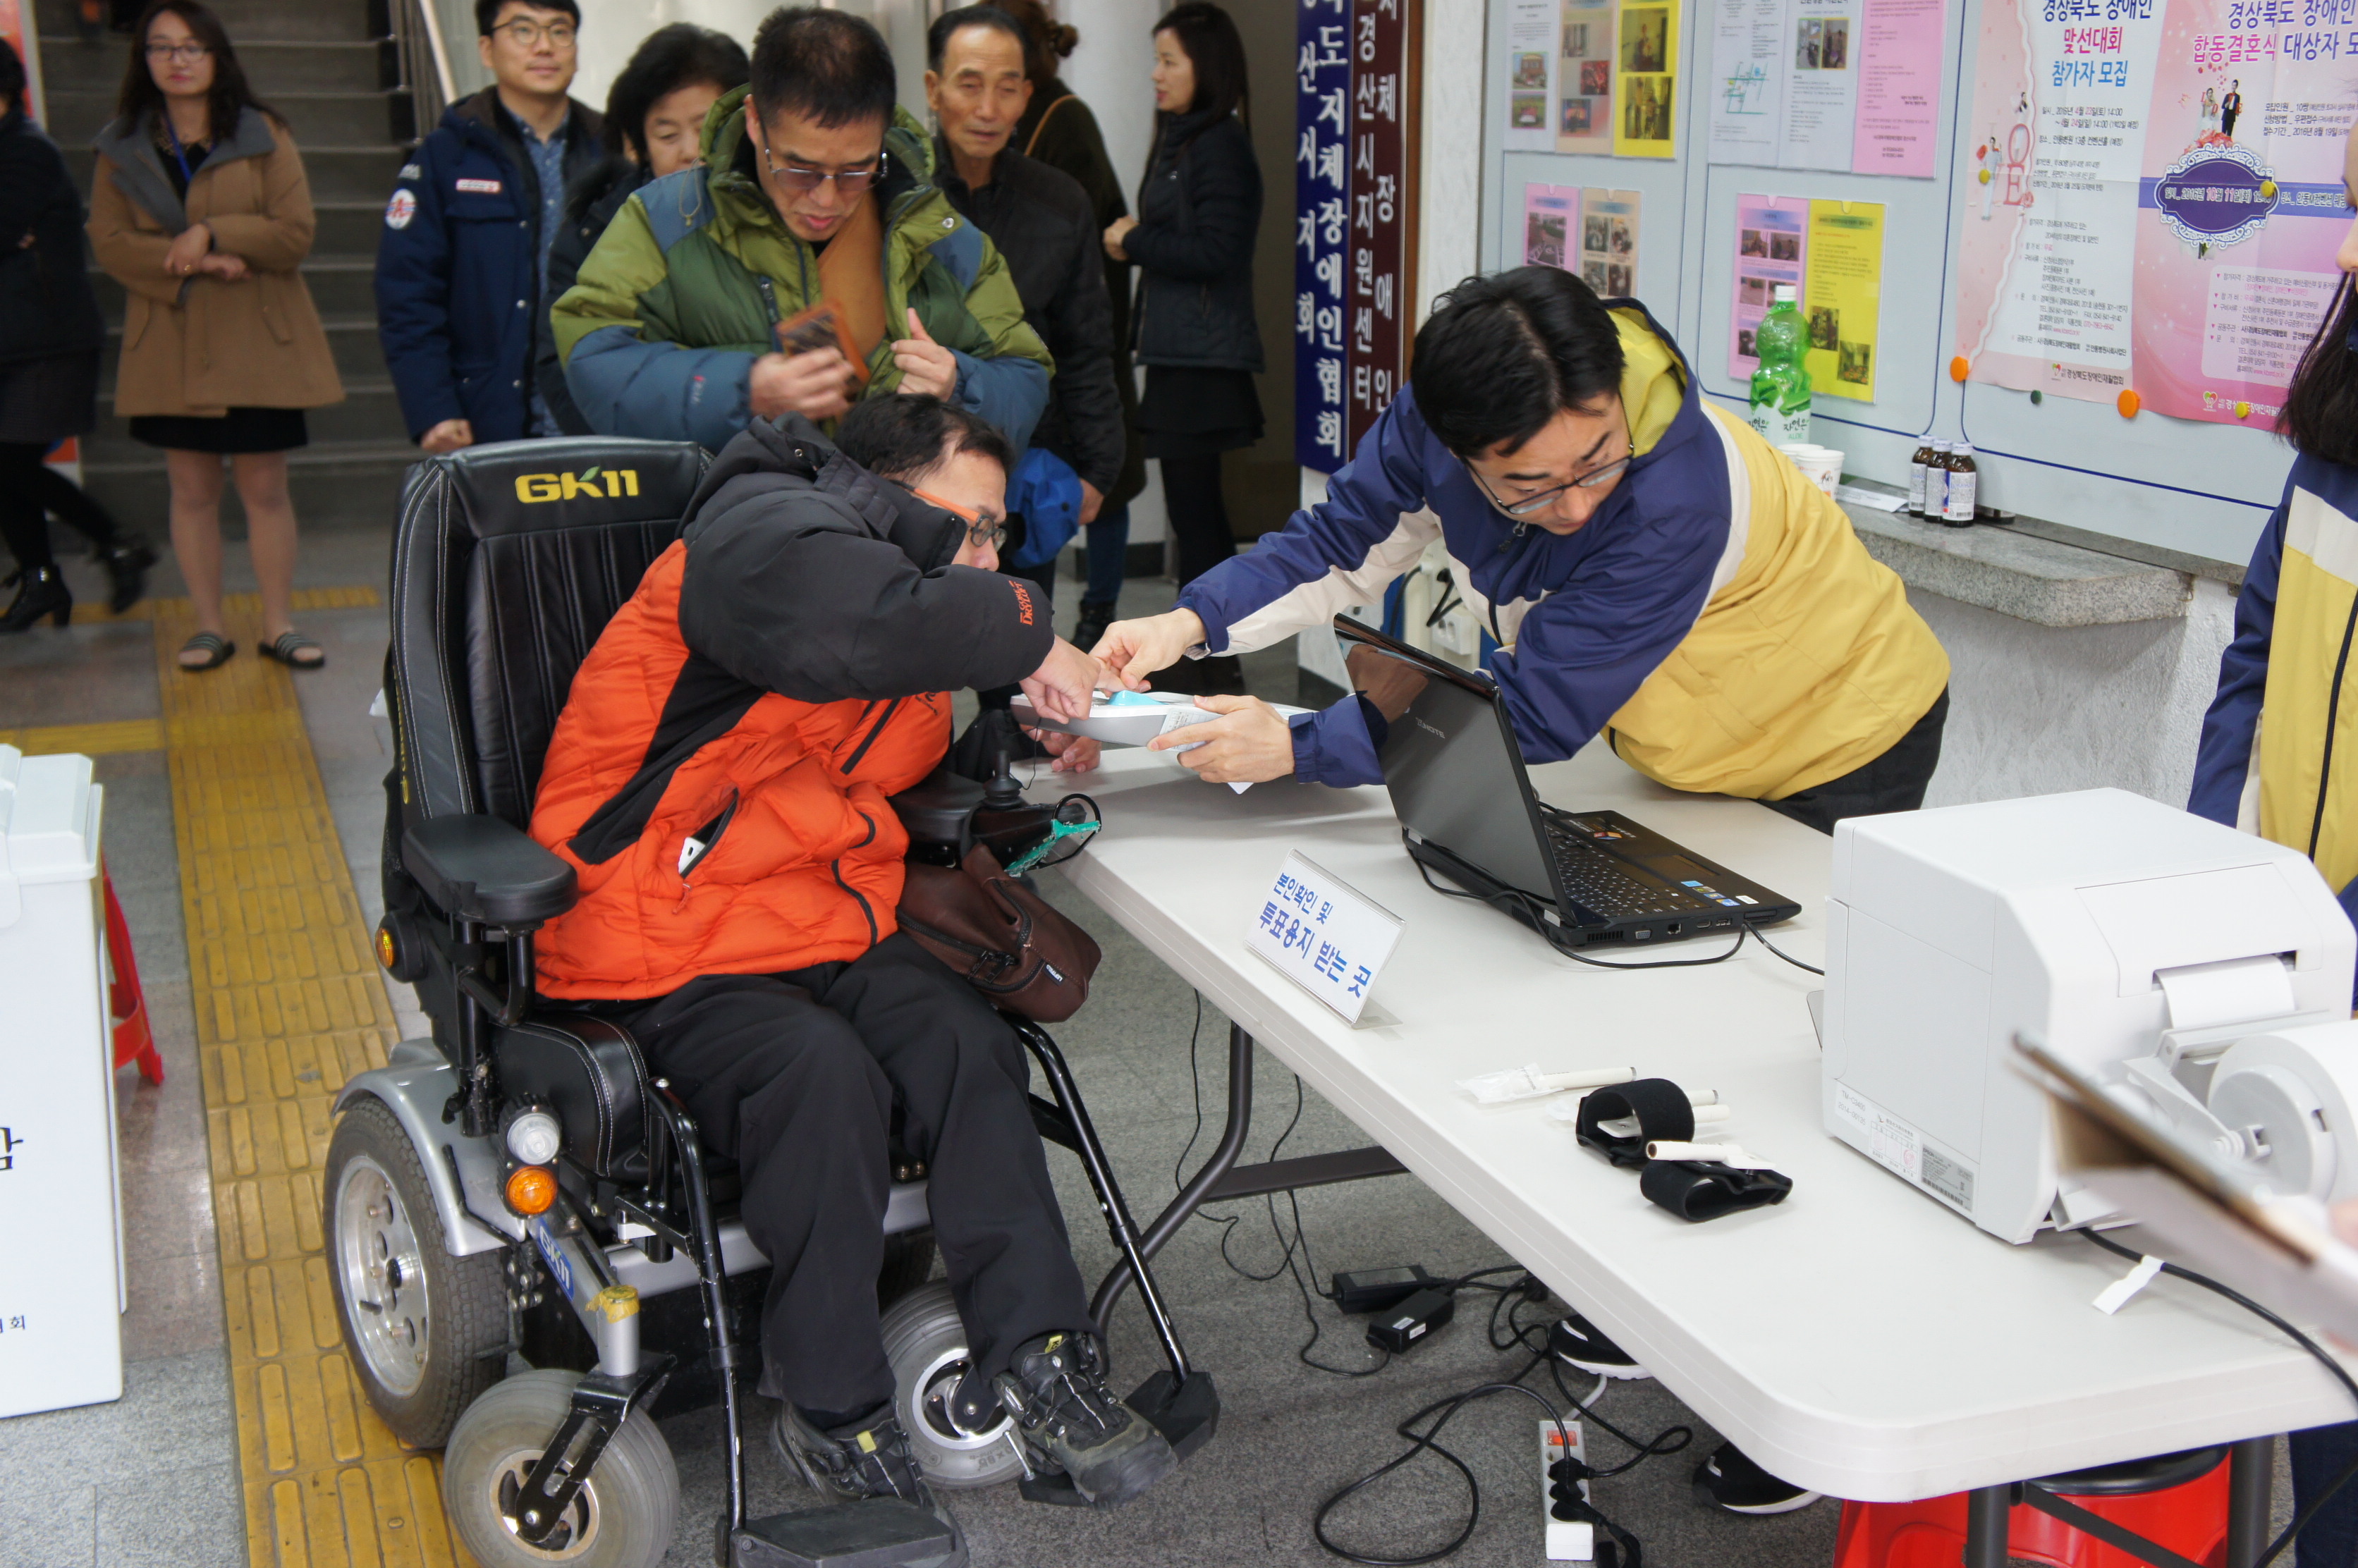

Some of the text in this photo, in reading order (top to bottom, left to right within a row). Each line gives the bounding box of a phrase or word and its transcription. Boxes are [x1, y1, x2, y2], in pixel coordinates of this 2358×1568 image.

[2228, 0, 2356, 30] 경상북도 장애인
[2064, 26, 2123, 54] 맞선대회
[2194, 33, 2278, 63] 합동결혼식
[2283, 31, 2340, 61] 대상자
[2052, 60, 2128, 87] 참가자 모집
[1783, 417, 1808, 431] 자연은
[515, 467, 639, 503] GK11
[1273, 872, 1333, 926] 본인확인 및
[1259, 900, 1372, 998] 투표용지 받는 곳
